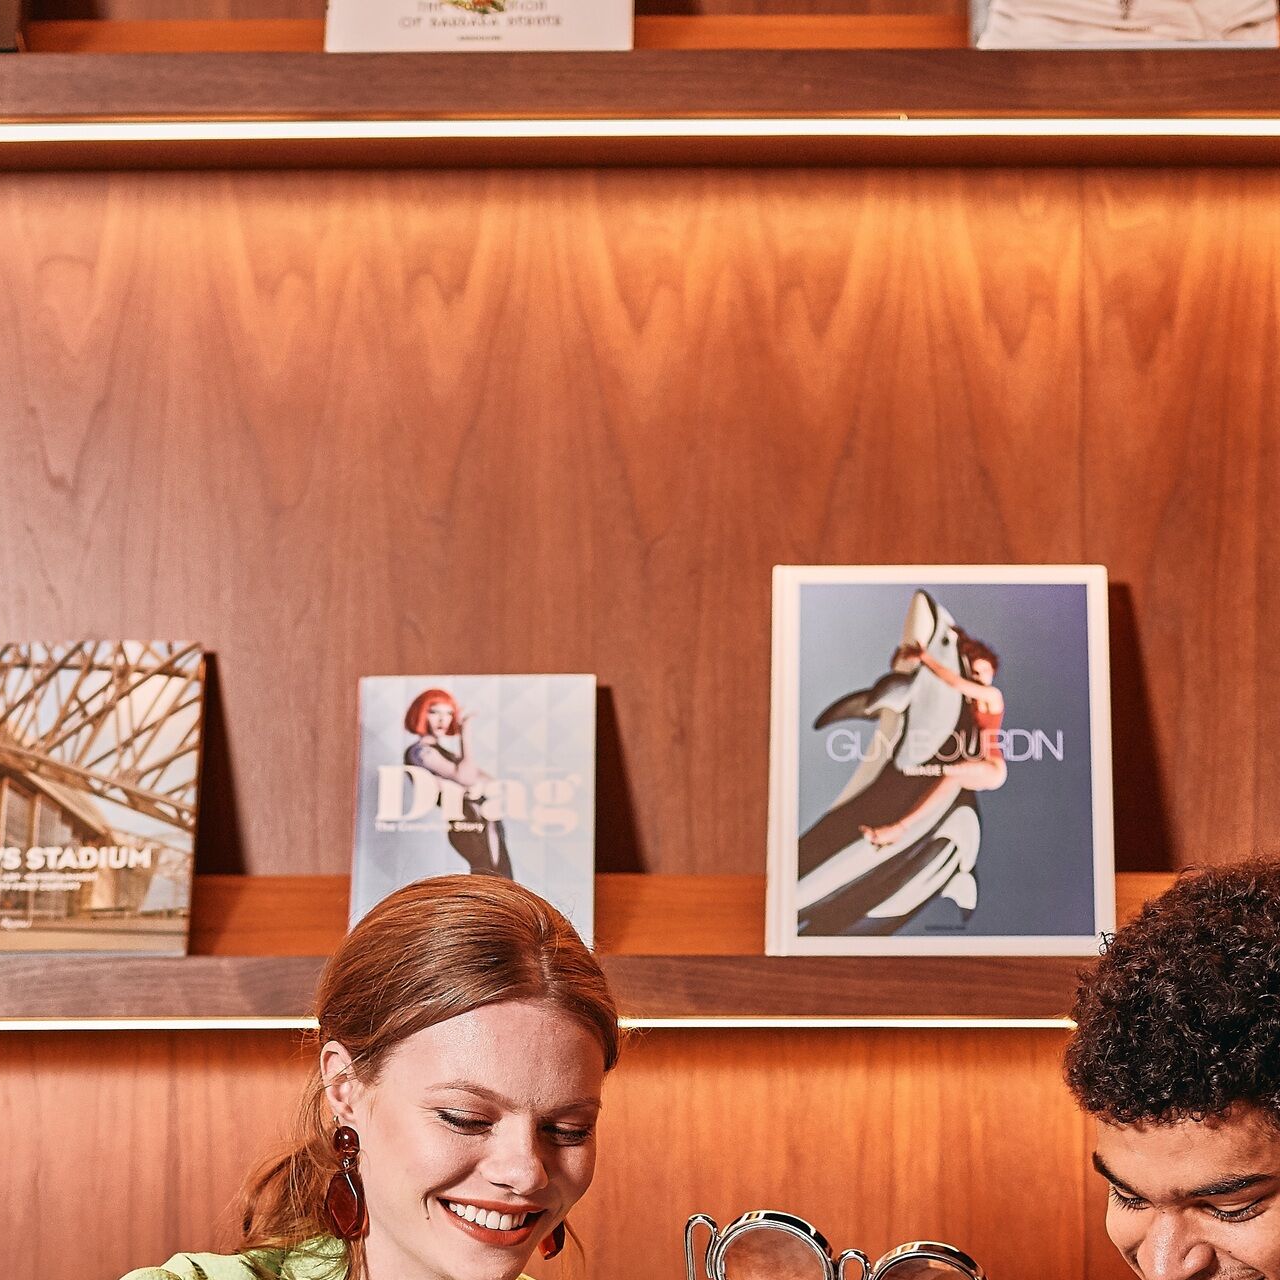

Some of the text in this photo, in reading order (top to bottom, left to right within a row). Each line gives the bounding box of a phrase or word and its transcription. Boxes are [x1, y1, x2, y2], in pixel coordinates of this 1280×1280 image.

[825, 728, 903, 762] GUY
[376, 765, 583, 837] Drag
[26, 846, 152, 870] STADIUM
